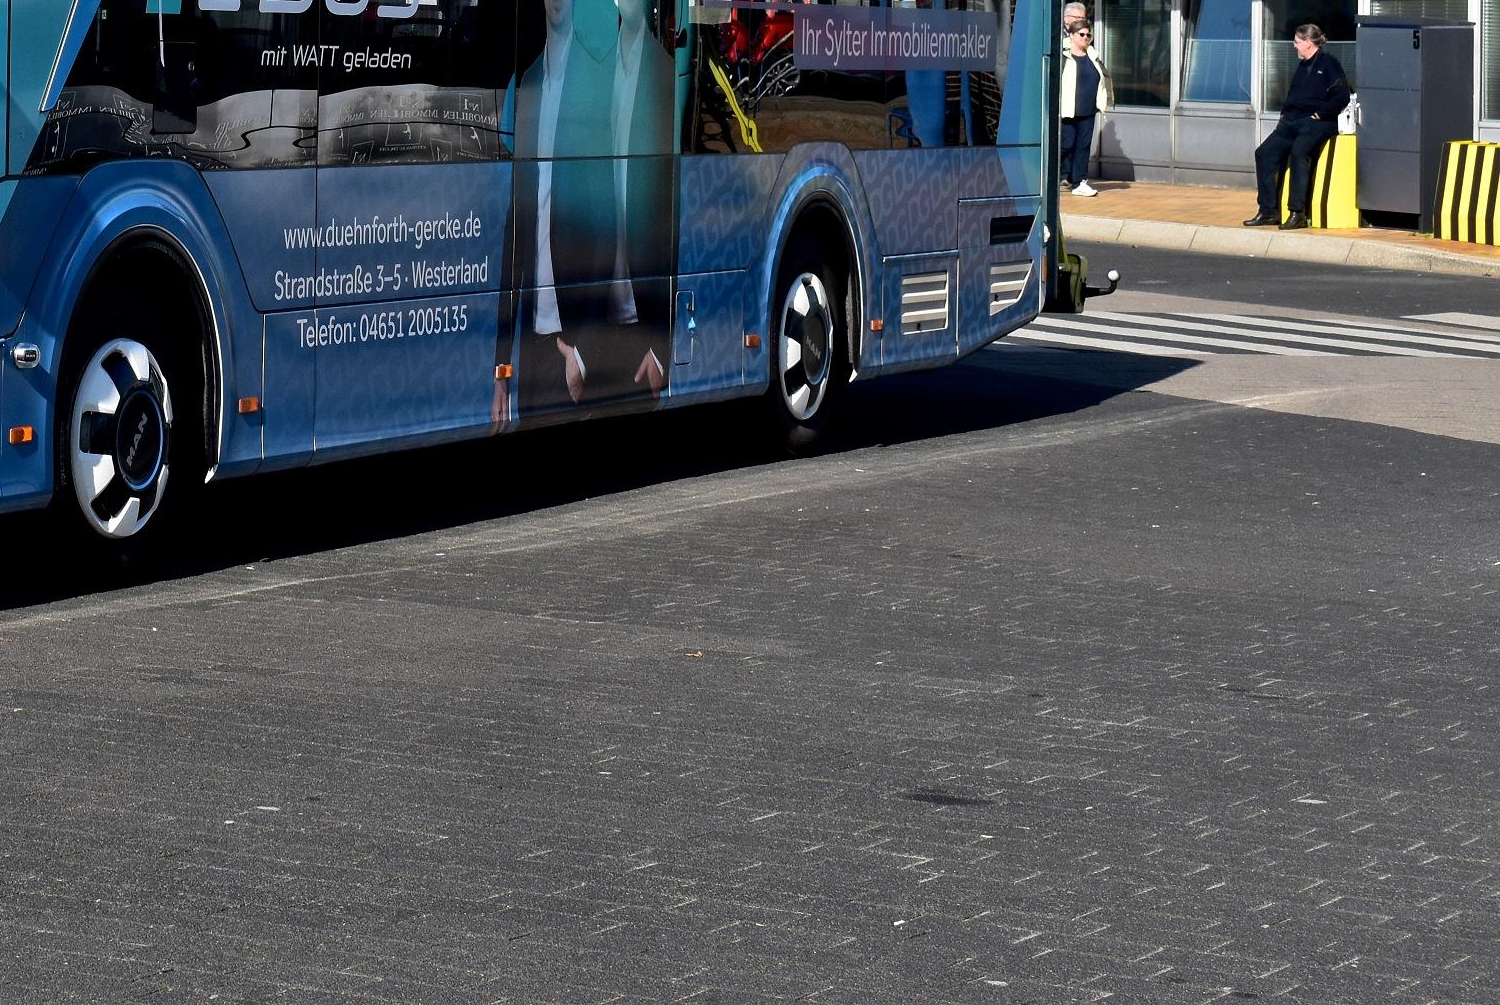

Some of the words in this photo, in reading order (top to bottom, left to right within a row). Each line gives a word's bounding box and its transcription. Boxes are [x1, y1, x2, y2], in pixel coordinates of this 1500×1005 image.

[260, 45, 288, 68] mit
[292, 44, 340, 69] WATT
[343, 45, 412, 73] geladen
[801, 18, 821, 57] Ihr
[825, 18, 868, 66] Sylter
[870, 19, 991, 60] Immobilienmakler
[1412, 30, 1420, 50] 5
[283, 210, 481, 250] www.duehnforth-gercke.de
[274, 264, 373, 301] Strandstraße
[411, 255, 488, 288] Westerland
[297, 316, 356, 348] Telefon:
[360, 311, 404, 342] 04651
[408, 304, 468, 337] 2005135
[127, 412, 148, 467] MAN
